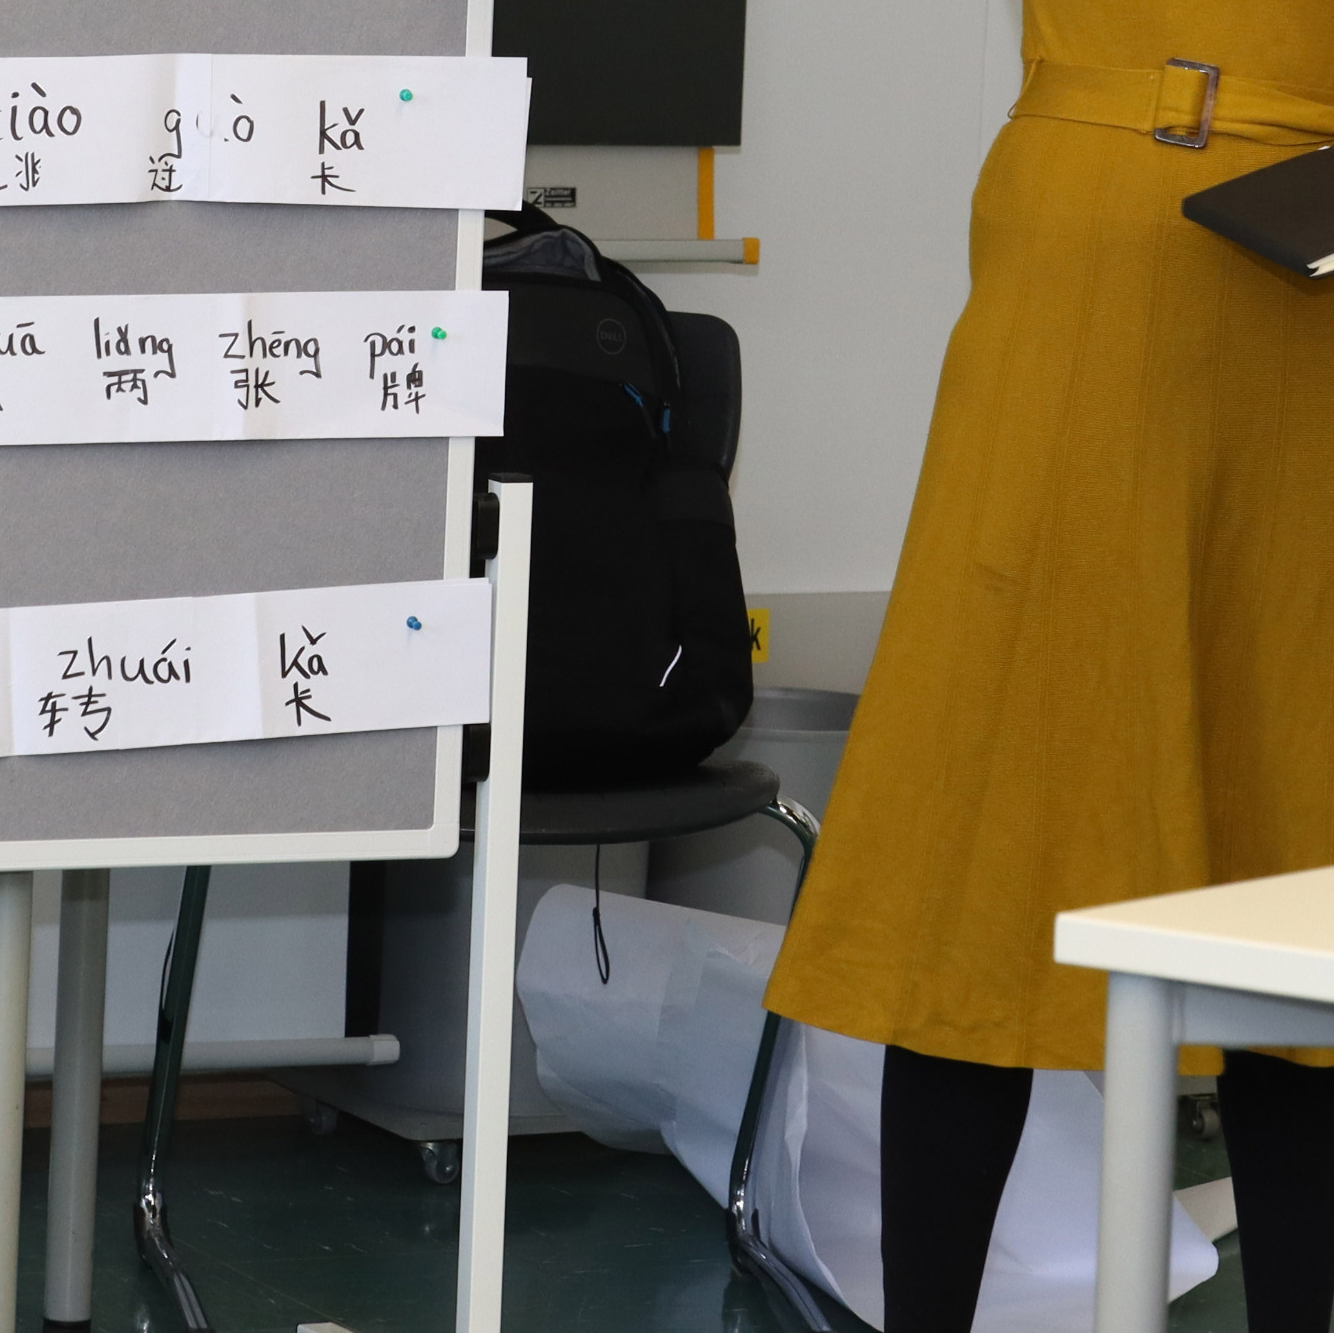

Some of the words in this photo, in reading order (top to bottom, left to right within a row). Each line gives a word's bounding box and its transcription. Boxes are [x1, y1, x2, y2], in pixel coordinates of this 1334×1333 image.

[318, 100, 365, 155] kǎ
[147, 155, 183, 193] 过
[310, 161, 355, 196] 卡
[93, 316, 177, 382] liǎng
[218, 319, 322, 382] zhēng
[363, 324, 420, 384] pái
[230, 366, 281, 411] 张
[380, 362, 426, 415] 牌
[57, 636, 192, 685] zhuái
[279, 625, 329, 680] kǎ
[38, 685, 112, 741] 转
[284, 681, 332, 727] 卡
